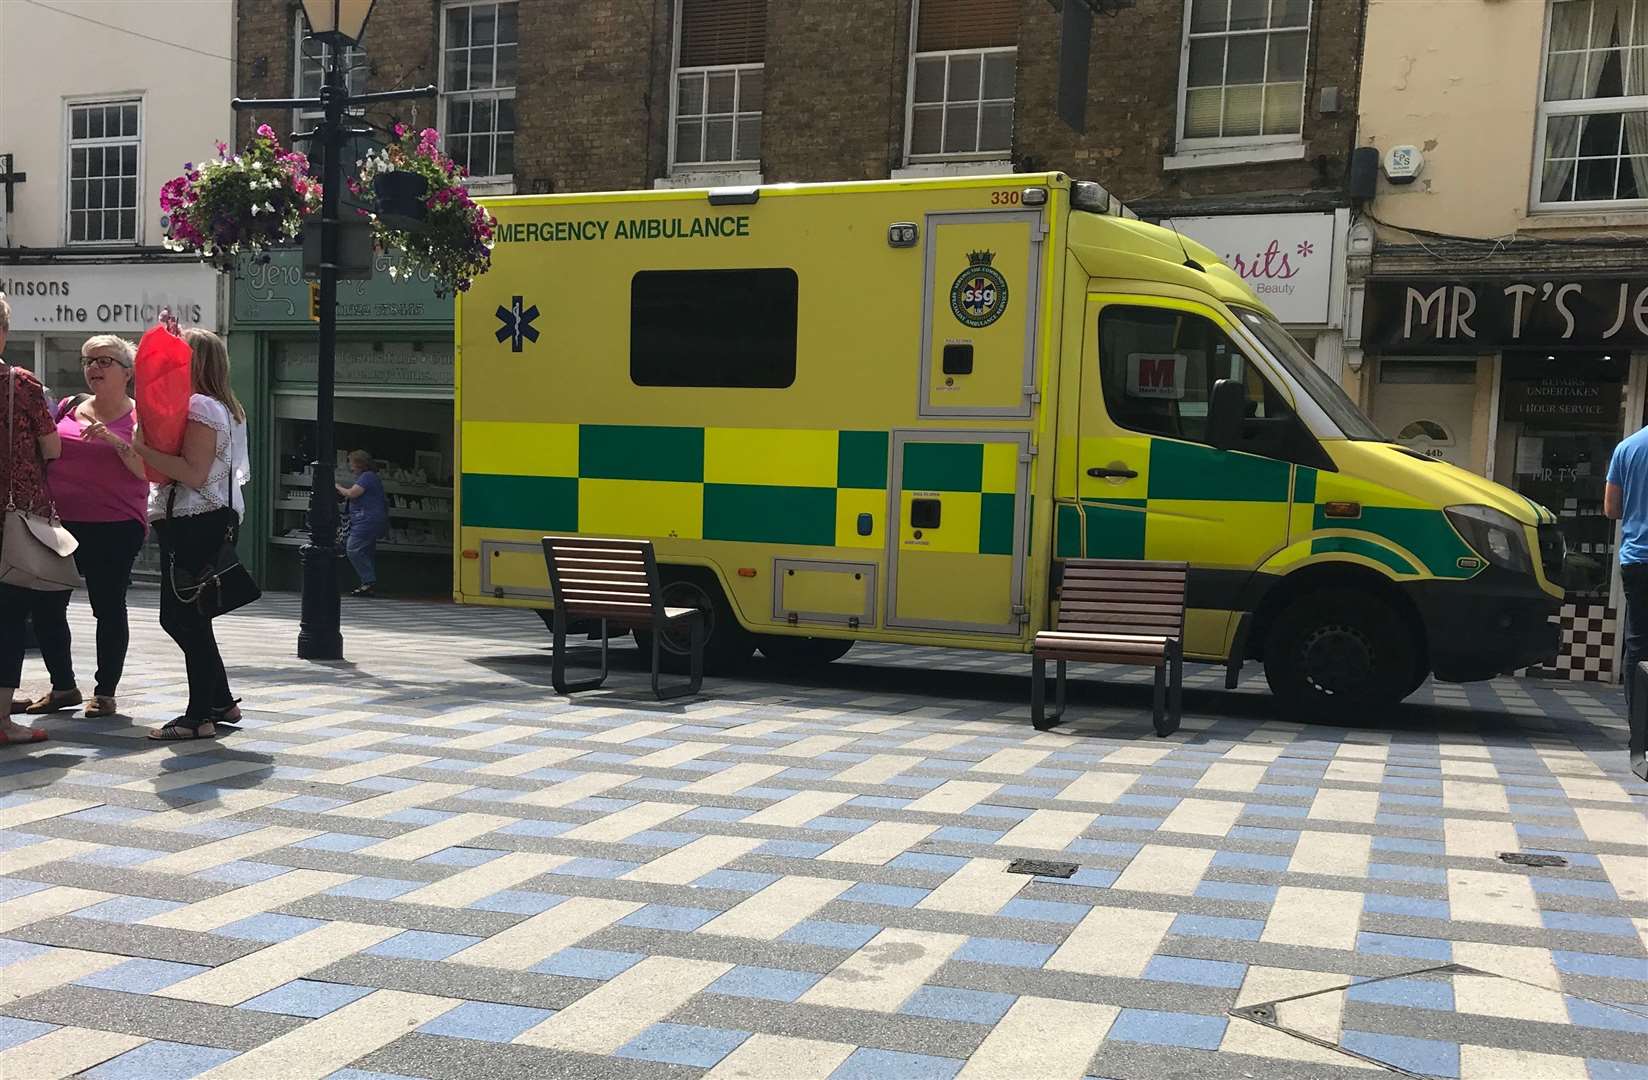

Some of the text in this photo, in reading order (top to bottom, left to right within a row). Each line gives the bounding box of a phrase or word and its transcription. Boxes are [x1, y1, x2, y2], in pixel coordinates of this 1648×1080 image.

[495, 216, 750, 243] MERGENCY AMBULANCE
[1228, 239, 1313, 280] rits
[1256, 282, 1296, 296] Beauty
[965, 289, 995, 306] ssg
[1403, 285, 1477, 339] MR
[1503, 281, 1583, 339] T'S
[1527, 387, 1599, 397] UNDERTAKEN
[1526, 403, 1557, 414] HOUR
[1558, 403, 1604, 415] SERVICE
[1425, 448, 1444, 458] 44b
